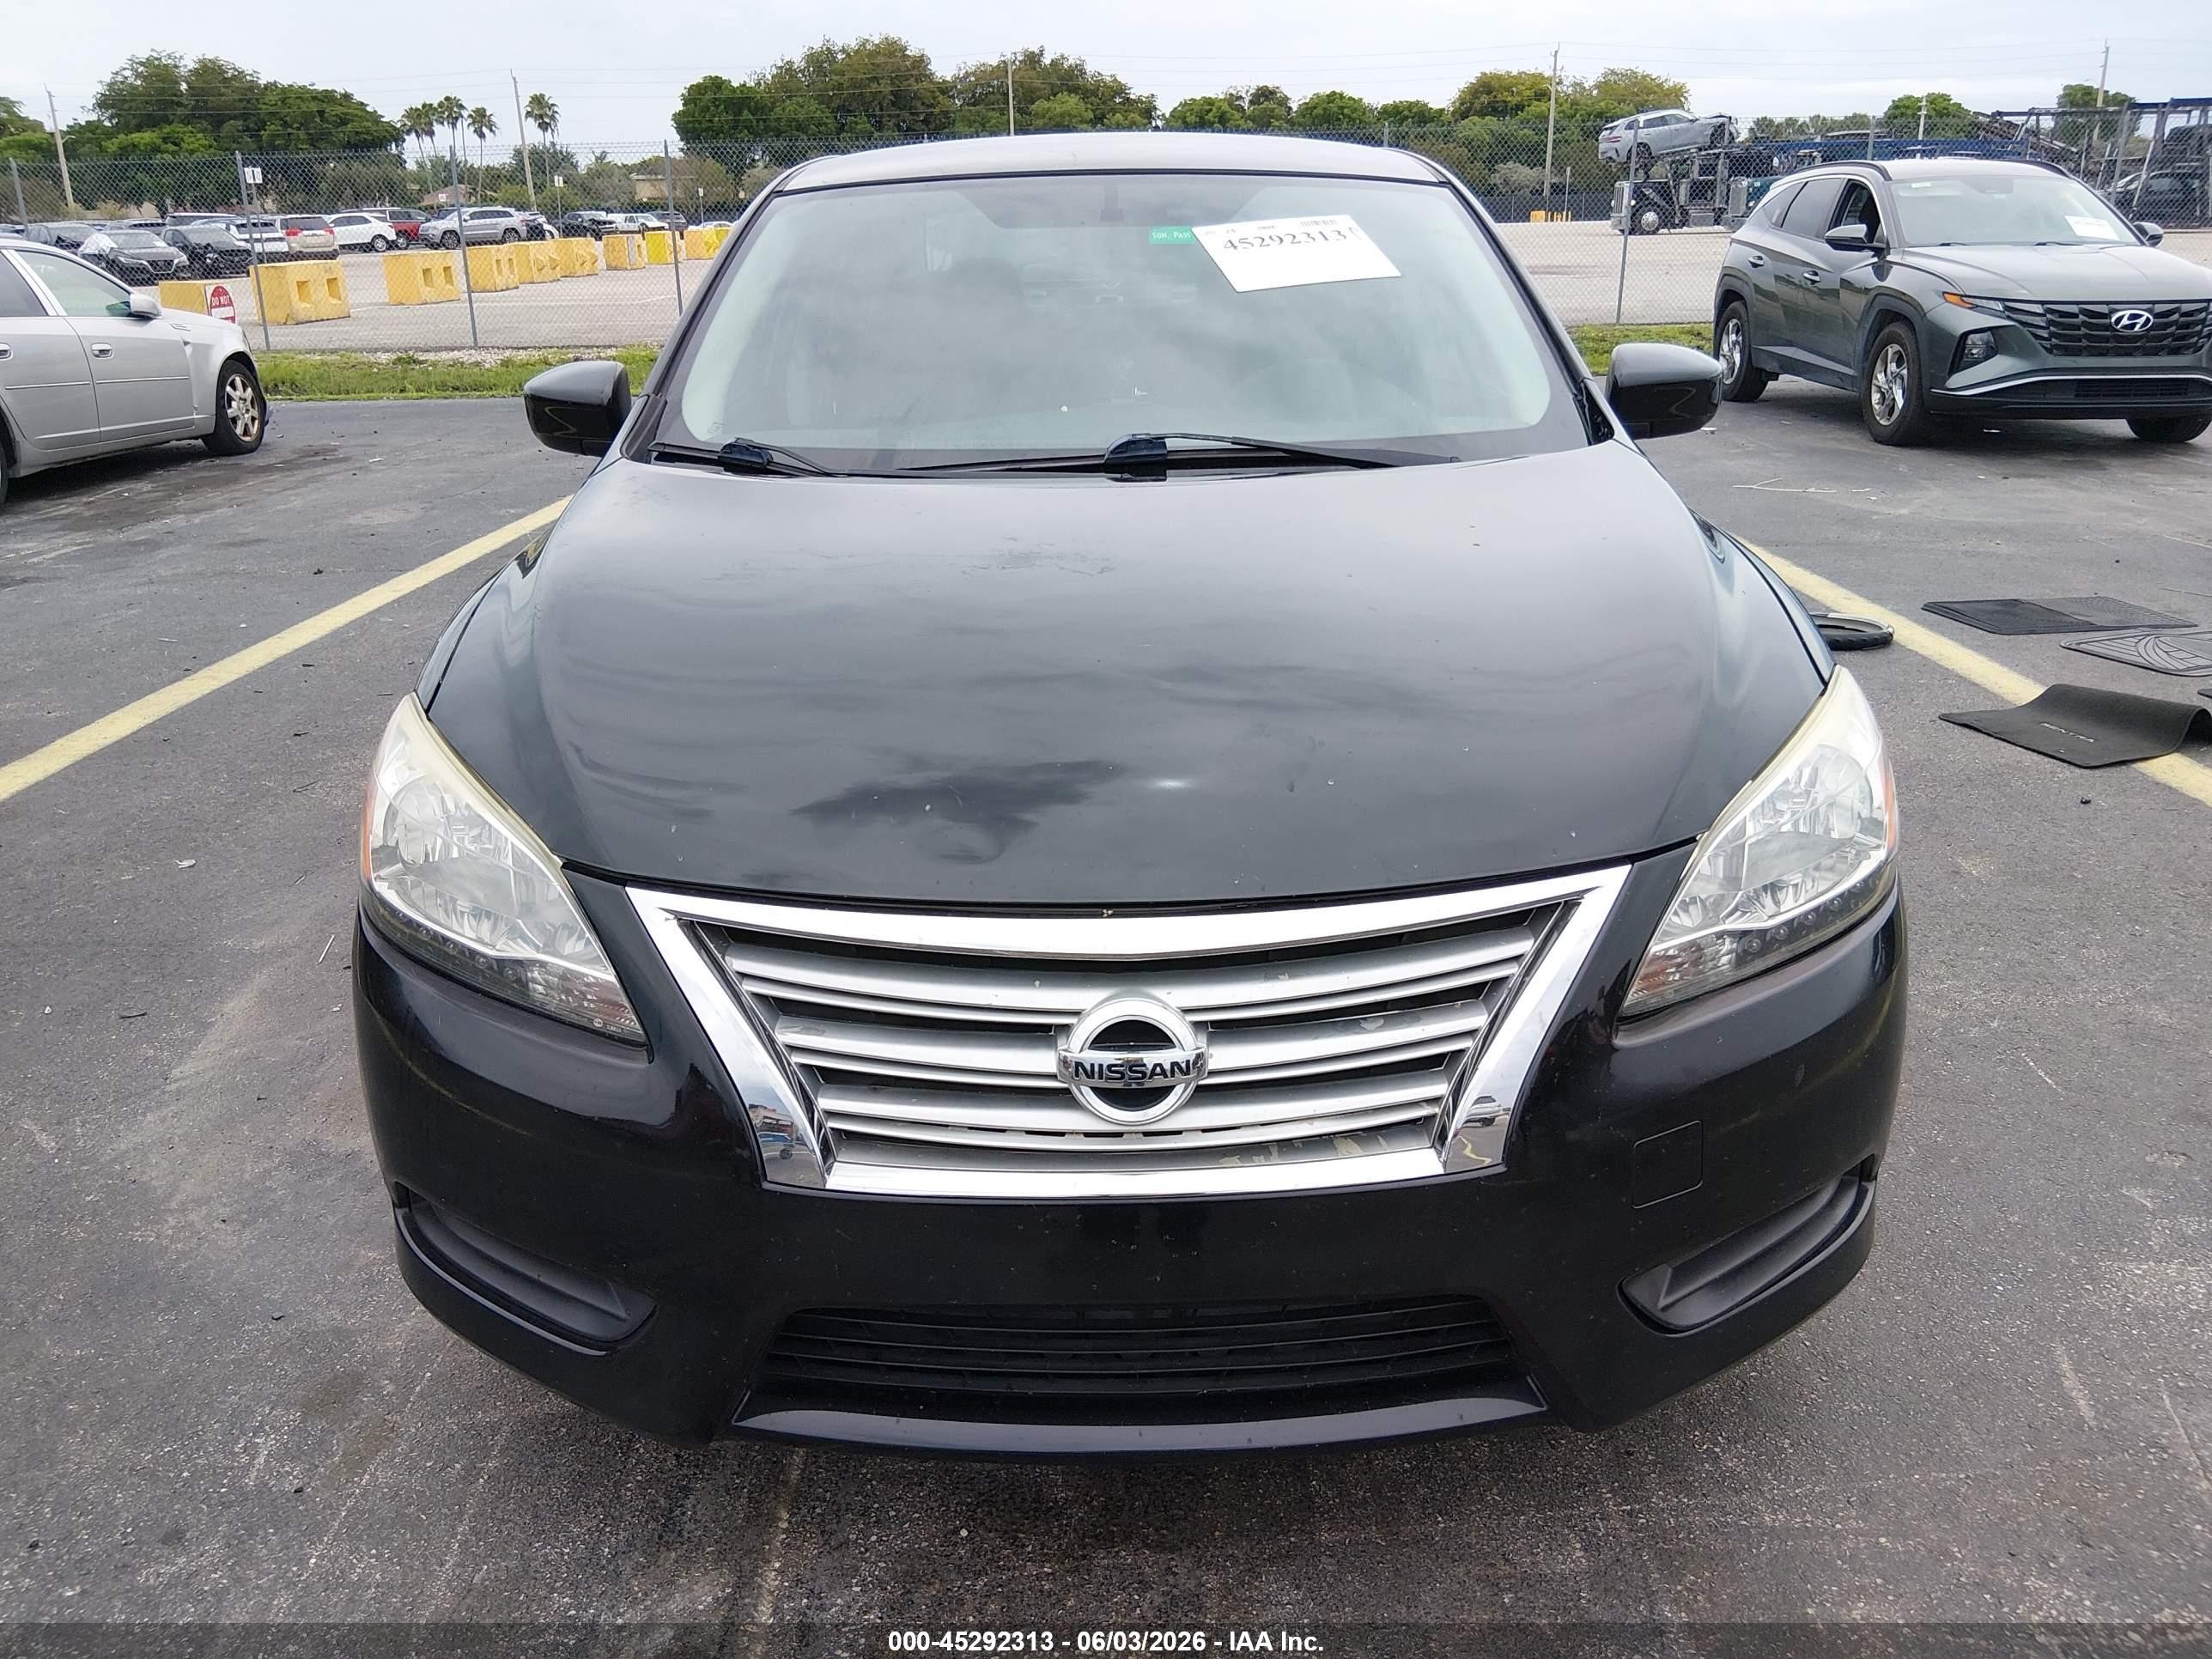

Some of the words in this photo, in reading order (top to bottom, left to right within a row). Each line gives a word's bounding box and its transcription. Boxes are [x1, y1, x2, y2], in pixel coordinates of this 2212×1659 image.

[1223, 229, 1348, 250] 45292313
[211, 296, 220, 307] DO
[220, 295, 231, 305] NOT
[2039, 722, 2095, 743] SENTRA
[1073, 1059, 1192, 1082] NISSAN
